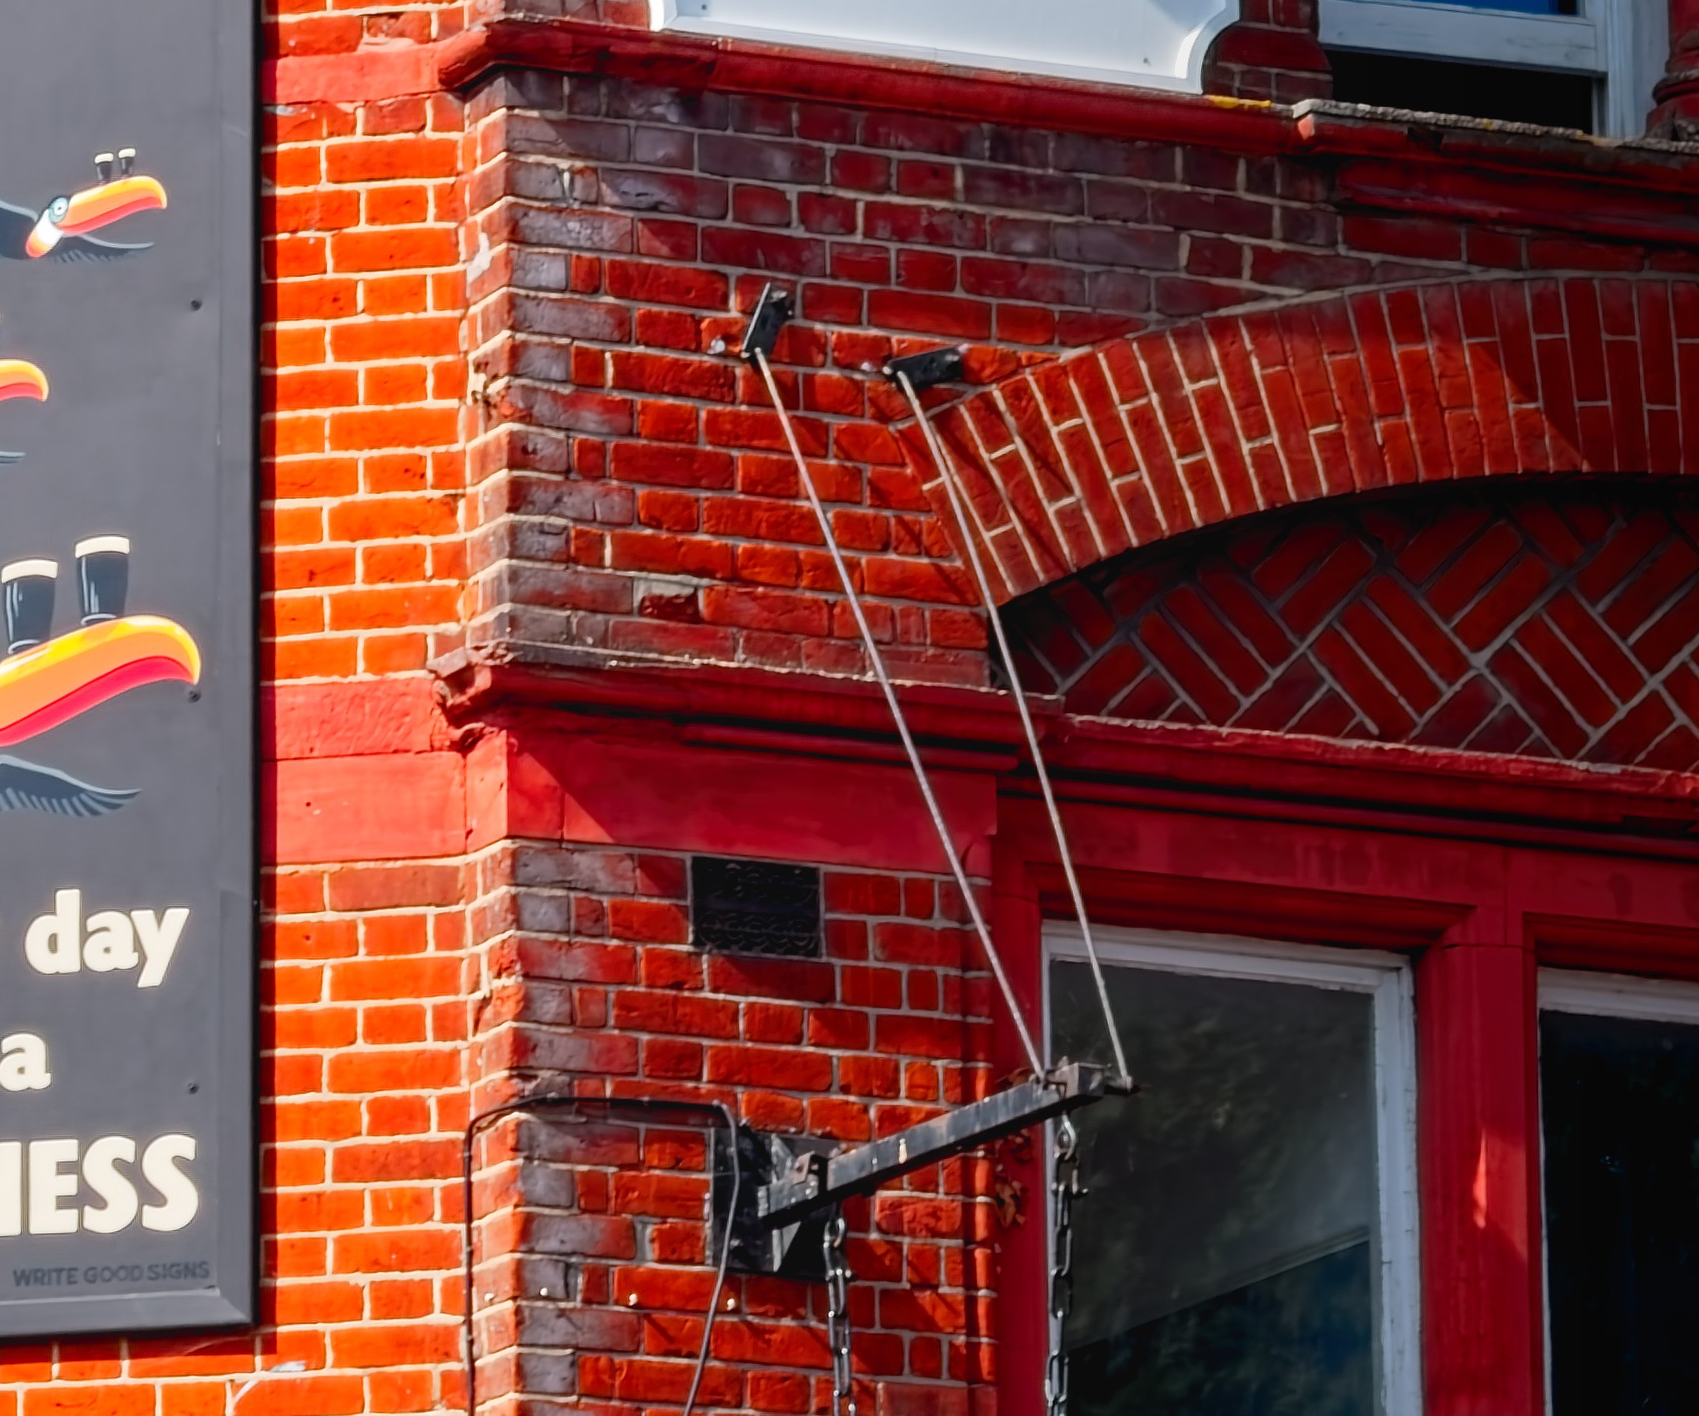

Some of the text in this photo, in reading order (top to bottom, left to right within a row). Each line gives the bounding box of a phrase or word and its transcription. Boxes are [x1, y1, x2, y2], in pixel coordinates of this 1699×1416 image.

[24, 888, 190, 989] day
[12, 1260, 211, 1287] WRITE GOOD SIGNS
